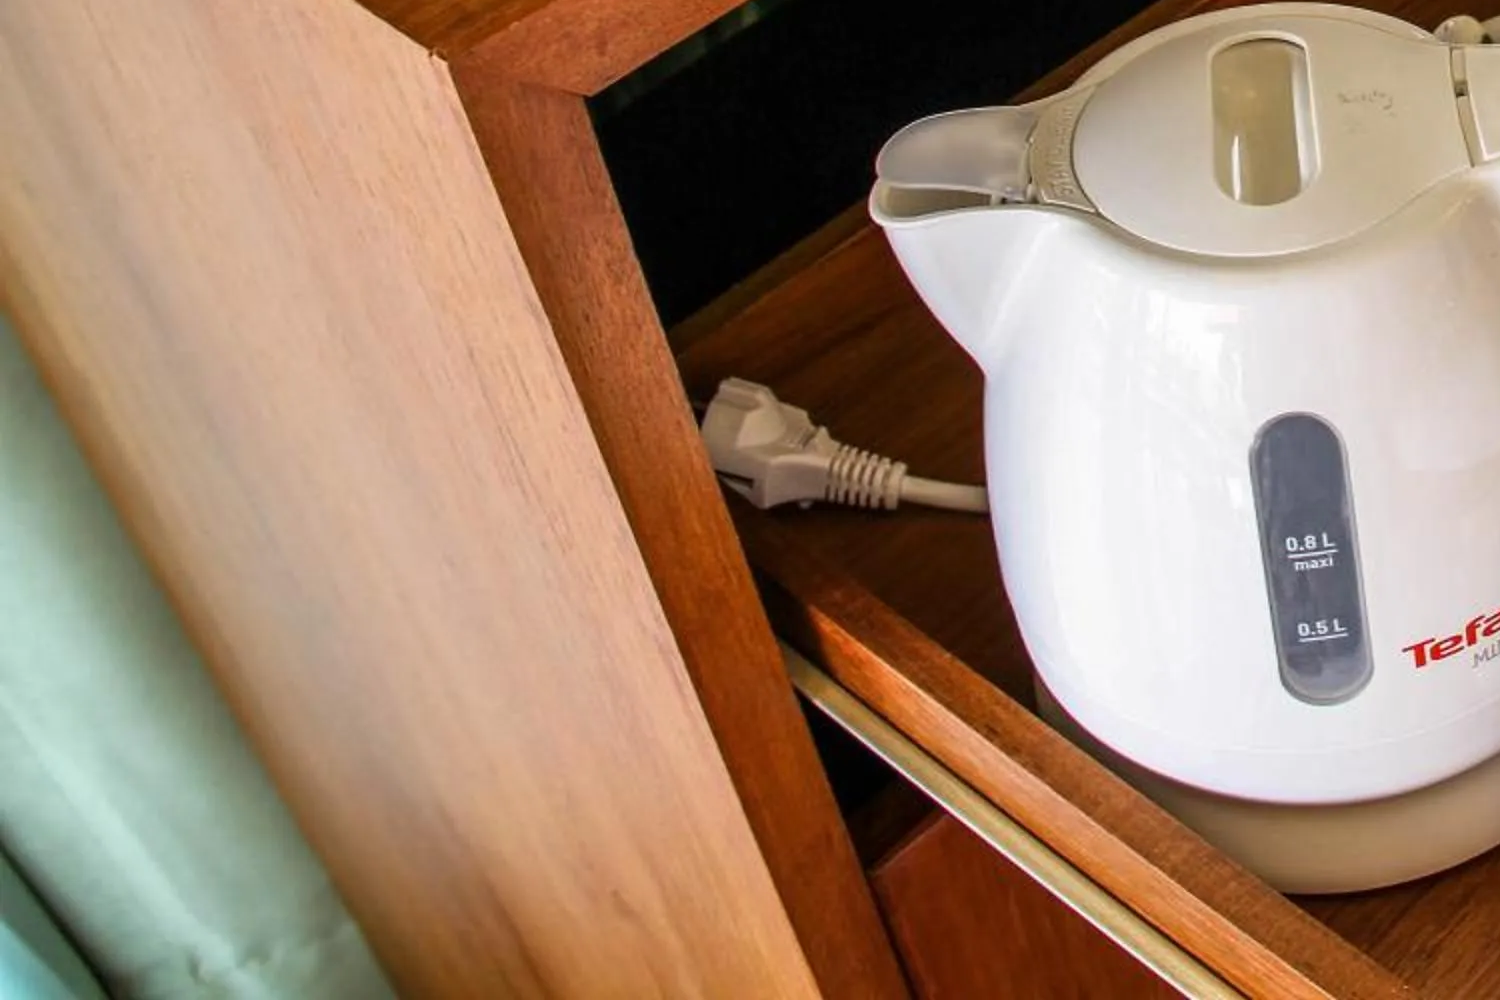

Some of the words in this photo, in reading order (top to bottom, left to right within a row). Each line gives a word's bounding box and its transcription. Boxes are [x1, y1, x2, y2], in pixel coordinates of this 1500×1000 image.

[1285, 535, 1317, 552] 0.8
[1322, 532, 1336, 548] L
[1294, 555, 1335, 572] maxi
[1297, 619, 1328, 637] 0.5
[1332, 617, 1348, 633] L
